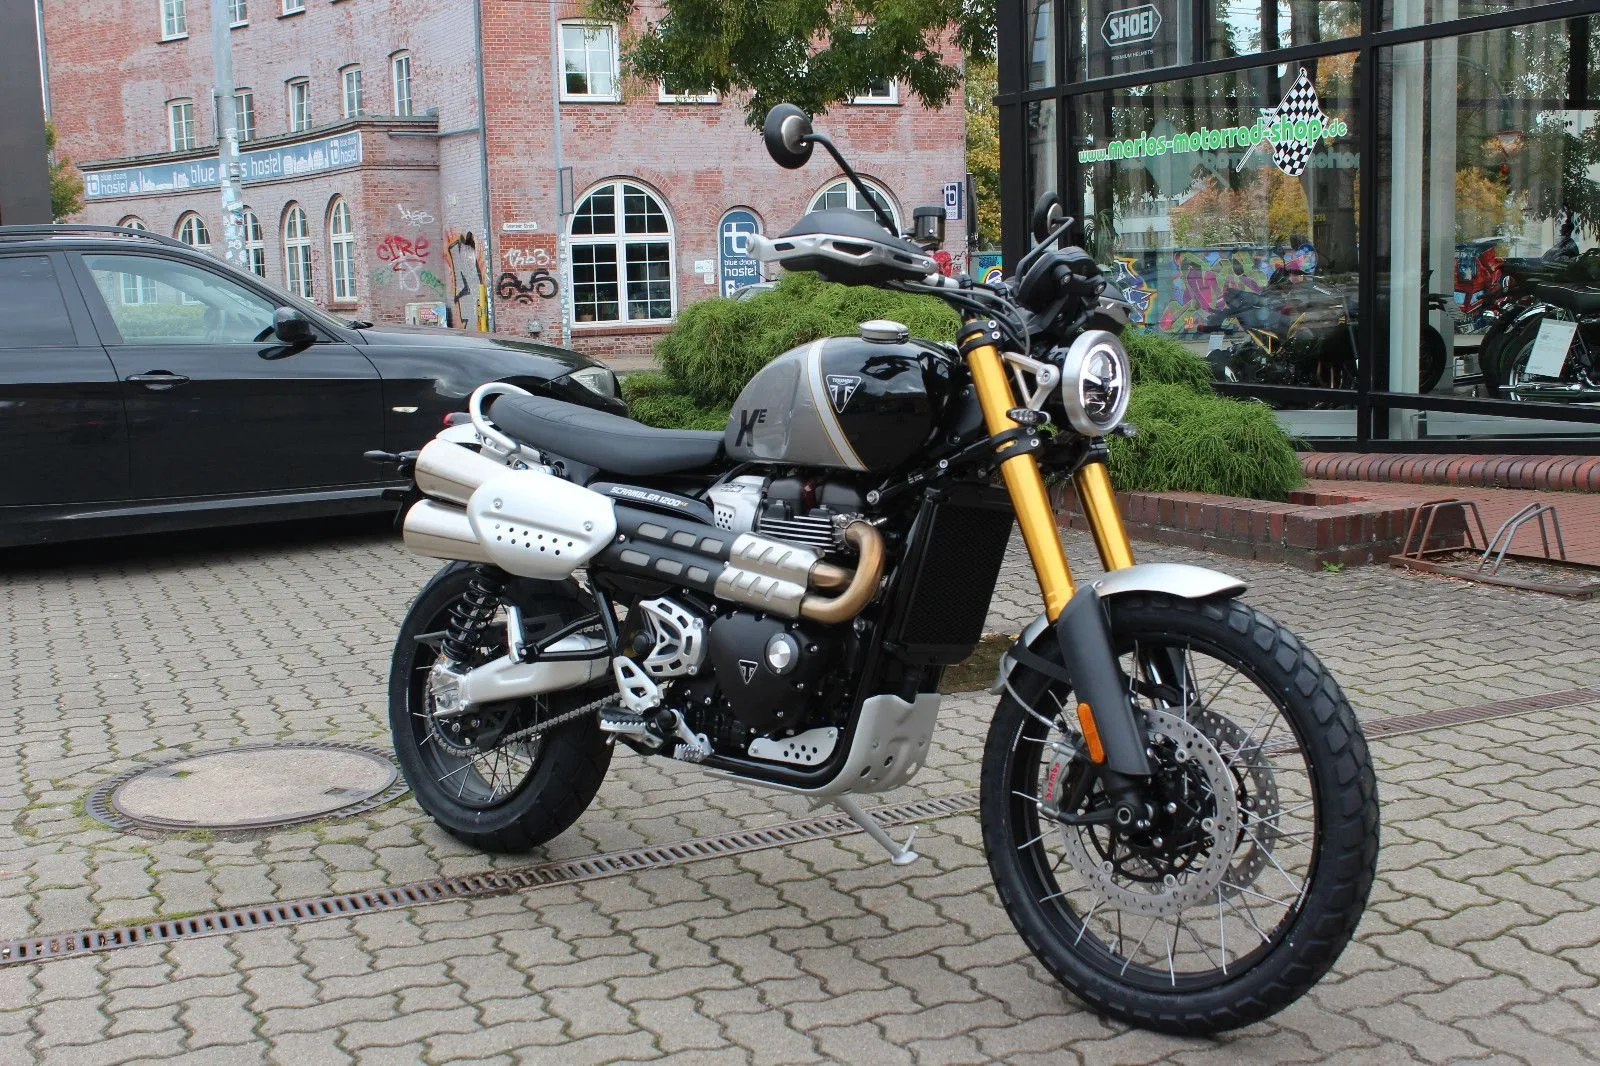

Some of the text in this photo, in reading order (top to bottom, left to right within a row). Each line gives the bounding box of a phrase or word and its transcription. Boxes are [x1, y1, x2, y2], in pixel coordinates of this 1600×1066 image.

[1109, 10, 1153, 40] SHOEI
[250, 152, 281, 176] hostel
[191, 165, 214, 183] blue
[100, 180, 128, 194] hostel
[725, 266, 756, 277] hostel
[610, 486, 658, 501] SCRAMBLER
